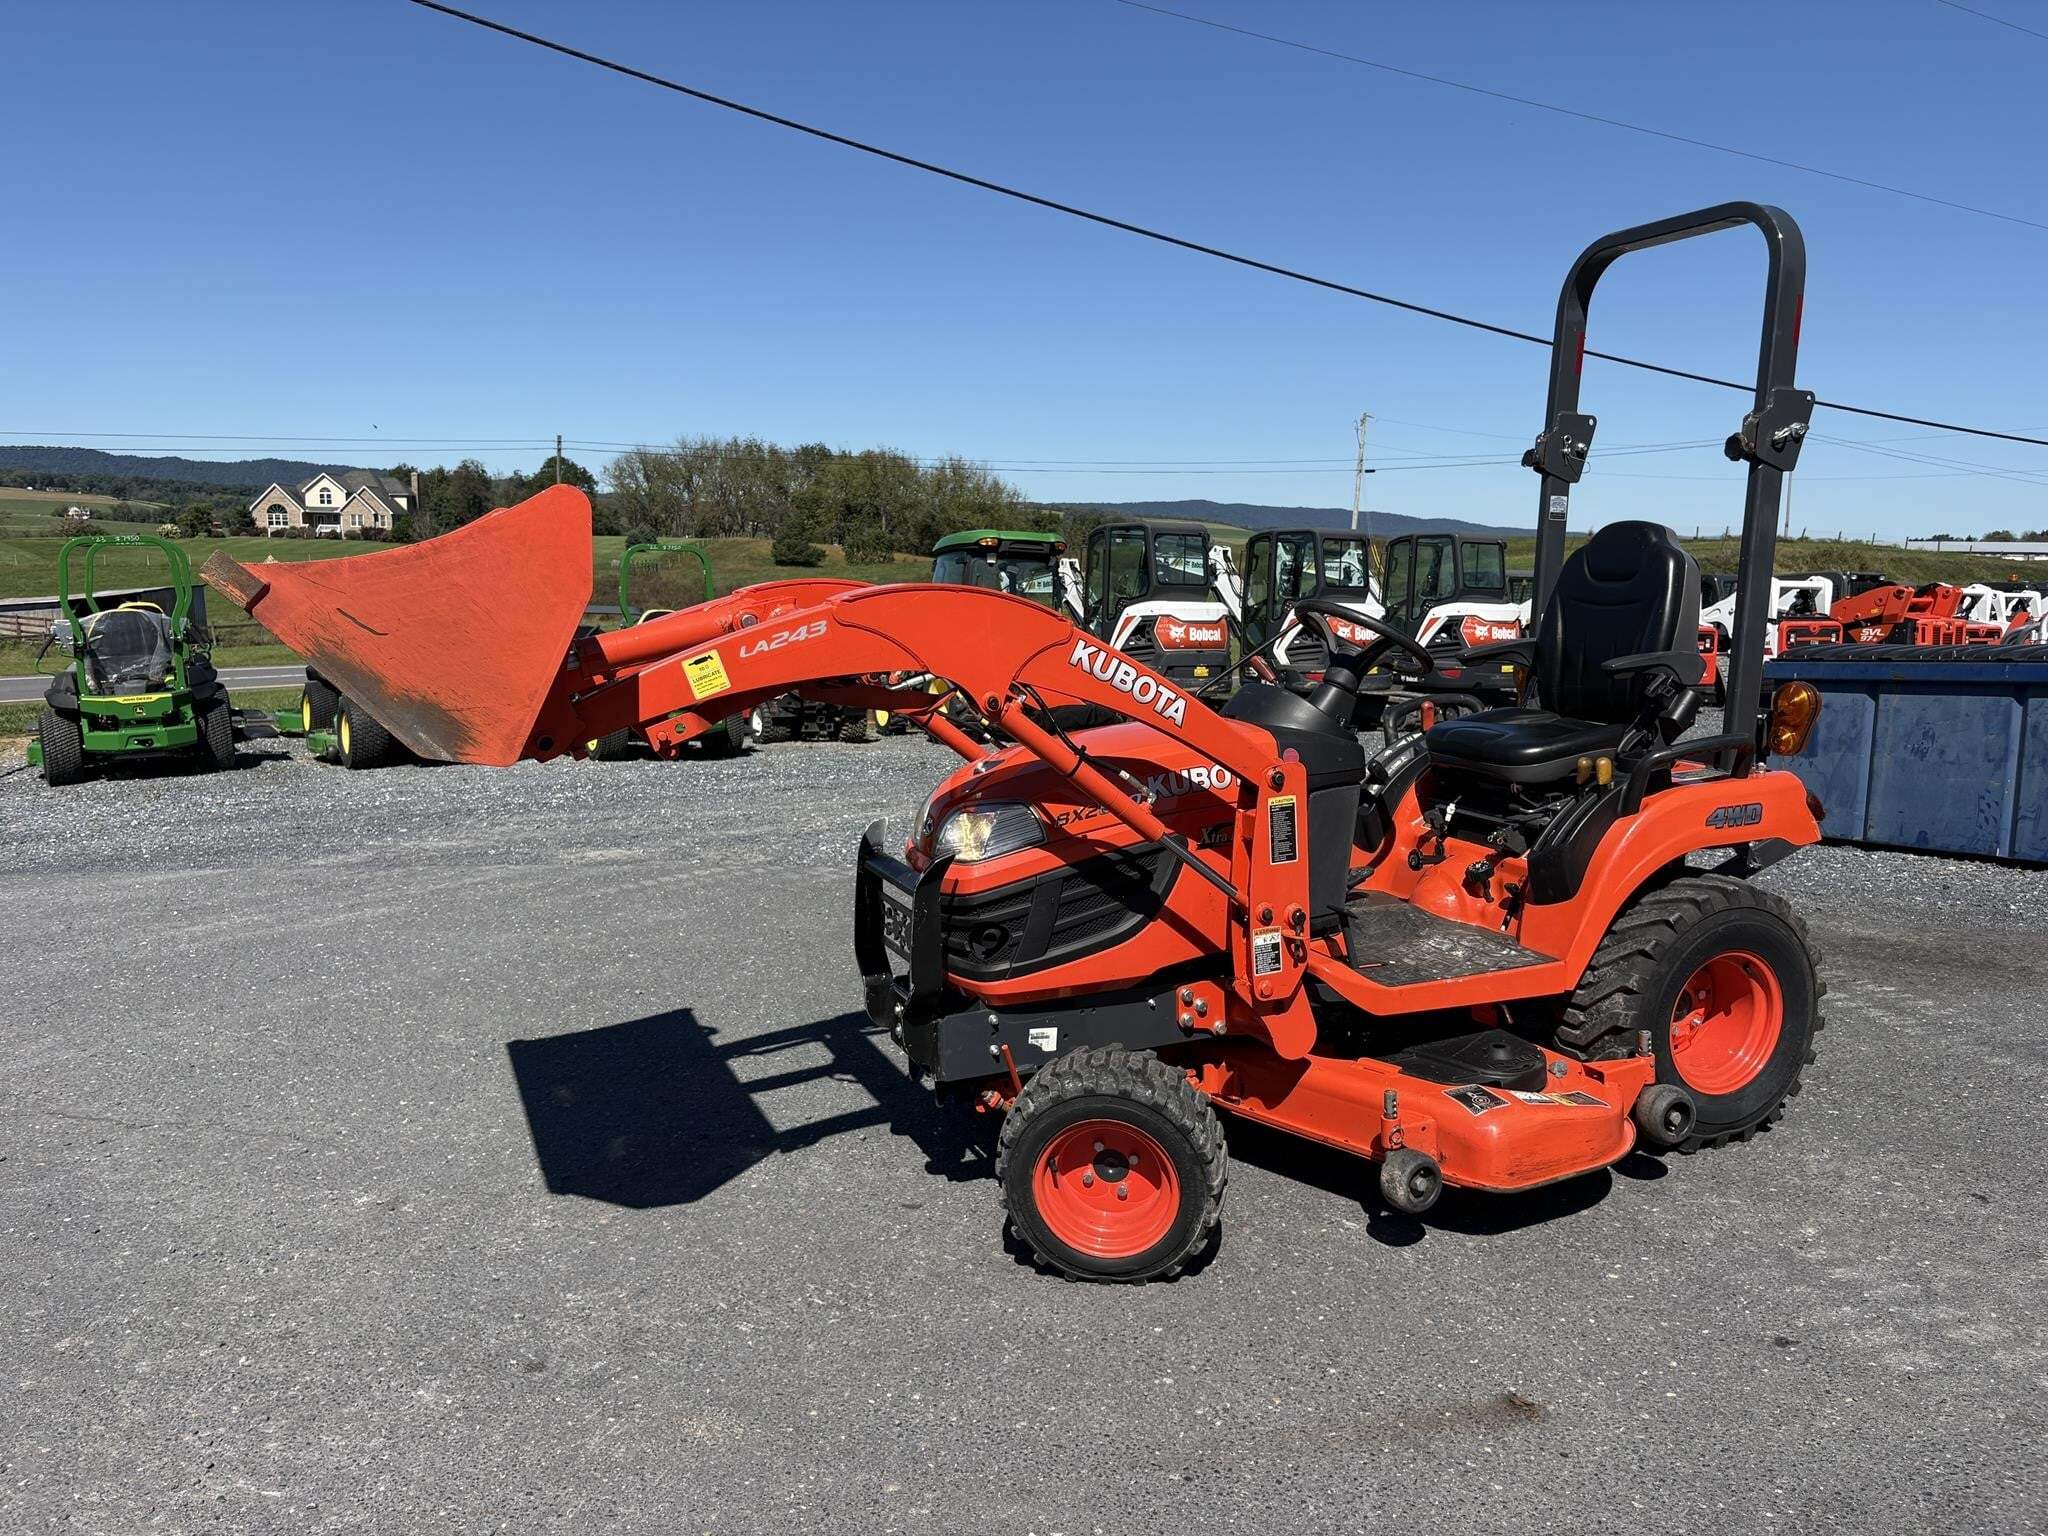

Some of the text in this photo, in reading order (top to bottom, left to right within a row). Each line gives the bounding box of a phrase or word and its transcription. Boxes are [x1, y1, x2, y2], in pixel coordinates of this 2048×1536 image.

[739, 619, 828, 659] LA243
[1189, 626, 1221, 642] Bobcat
[1491, 626, 1517, 640] Bobcat
[1860, 628, 1885, 636] SVL
[692, 668, 722, 684] LUBRICATE
[1068, 638, 1188, 729] KUBOTA
[1147, 763, 1242, 798] KUBO
[1705, 802, 1764, 829] 4WD
[1199, 826, 1229, 845] Xtra
